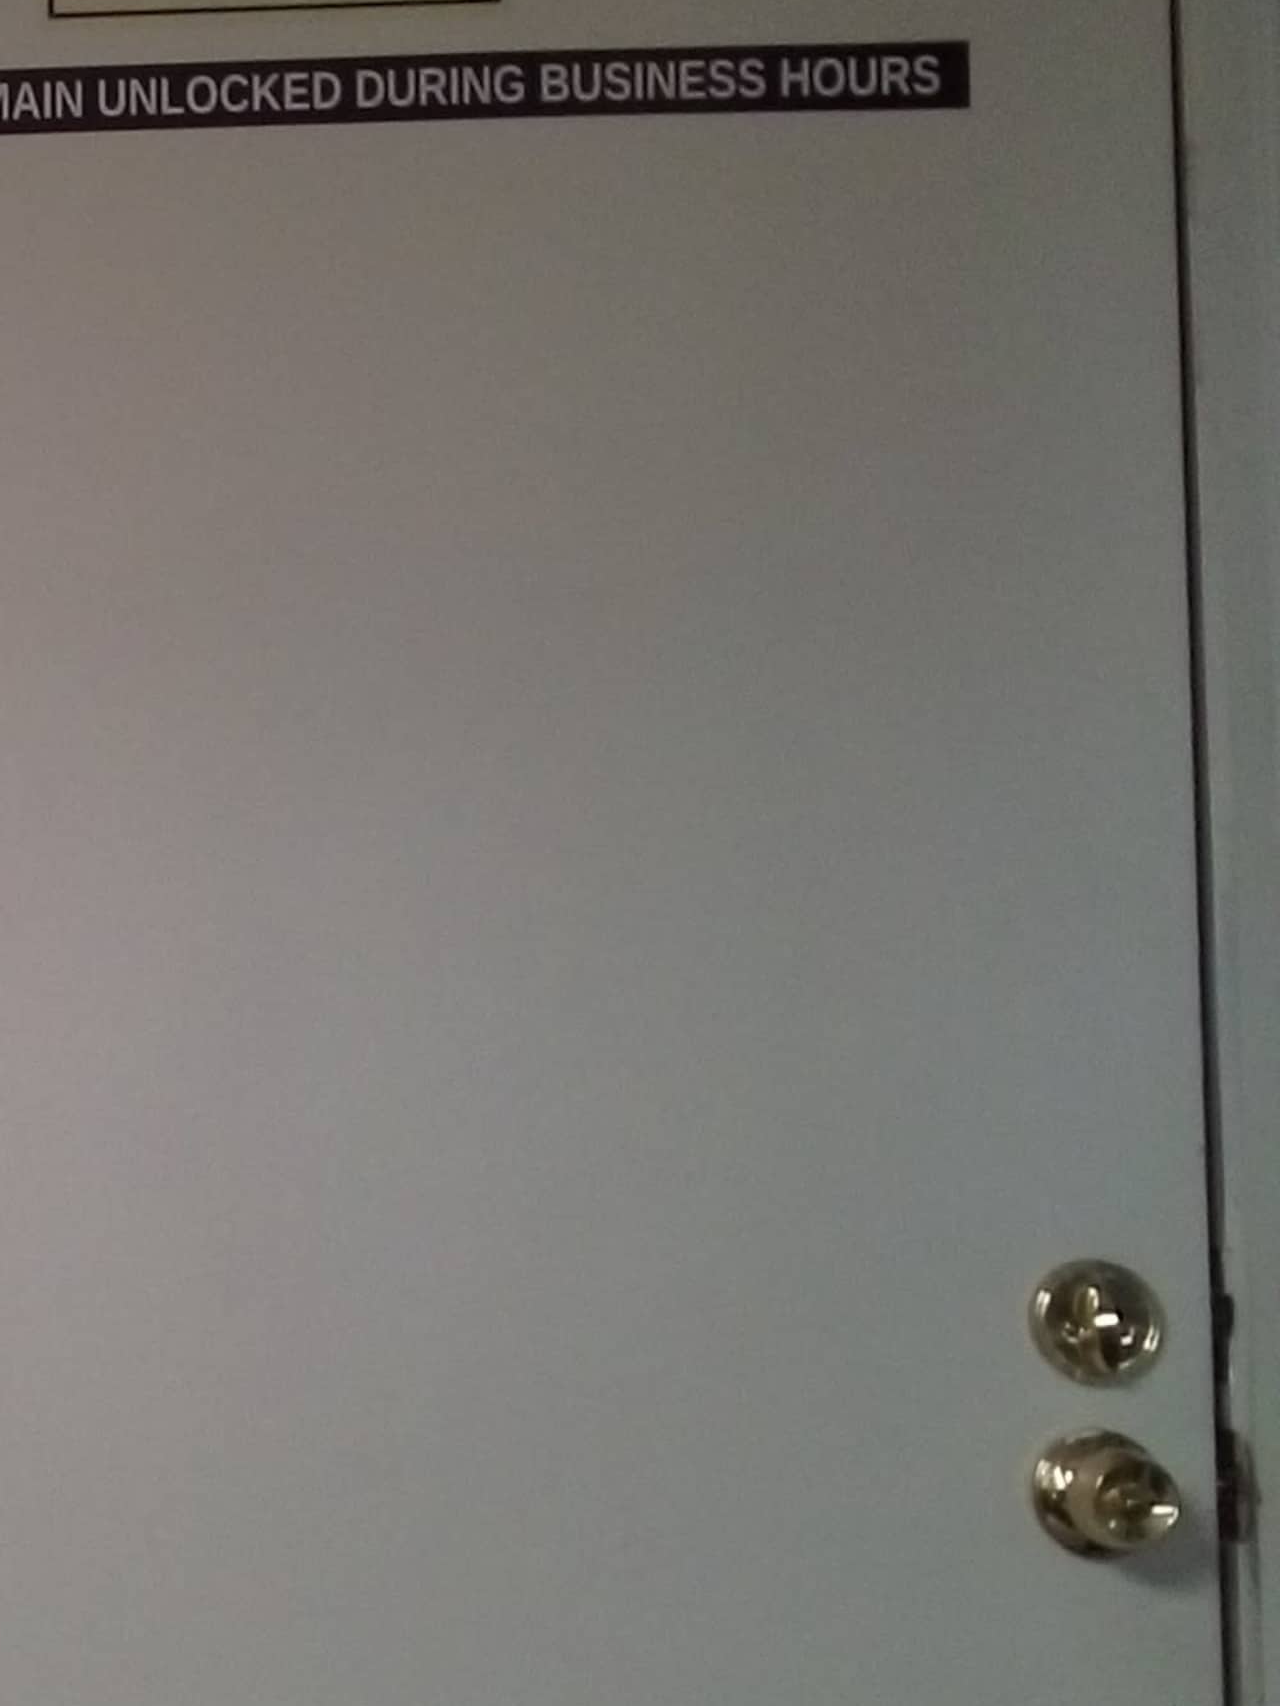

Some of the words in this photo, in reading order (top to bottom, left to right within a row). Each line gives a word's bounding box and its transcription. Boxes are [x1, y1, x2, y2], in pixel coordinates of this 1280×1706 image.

[97, 70, 342, 118] UNLOCKED
[355, 63, 526, 109] DURING
[540, 56, 766, 104] BUSINESS
[780, 53, 940, 98] HOURS
